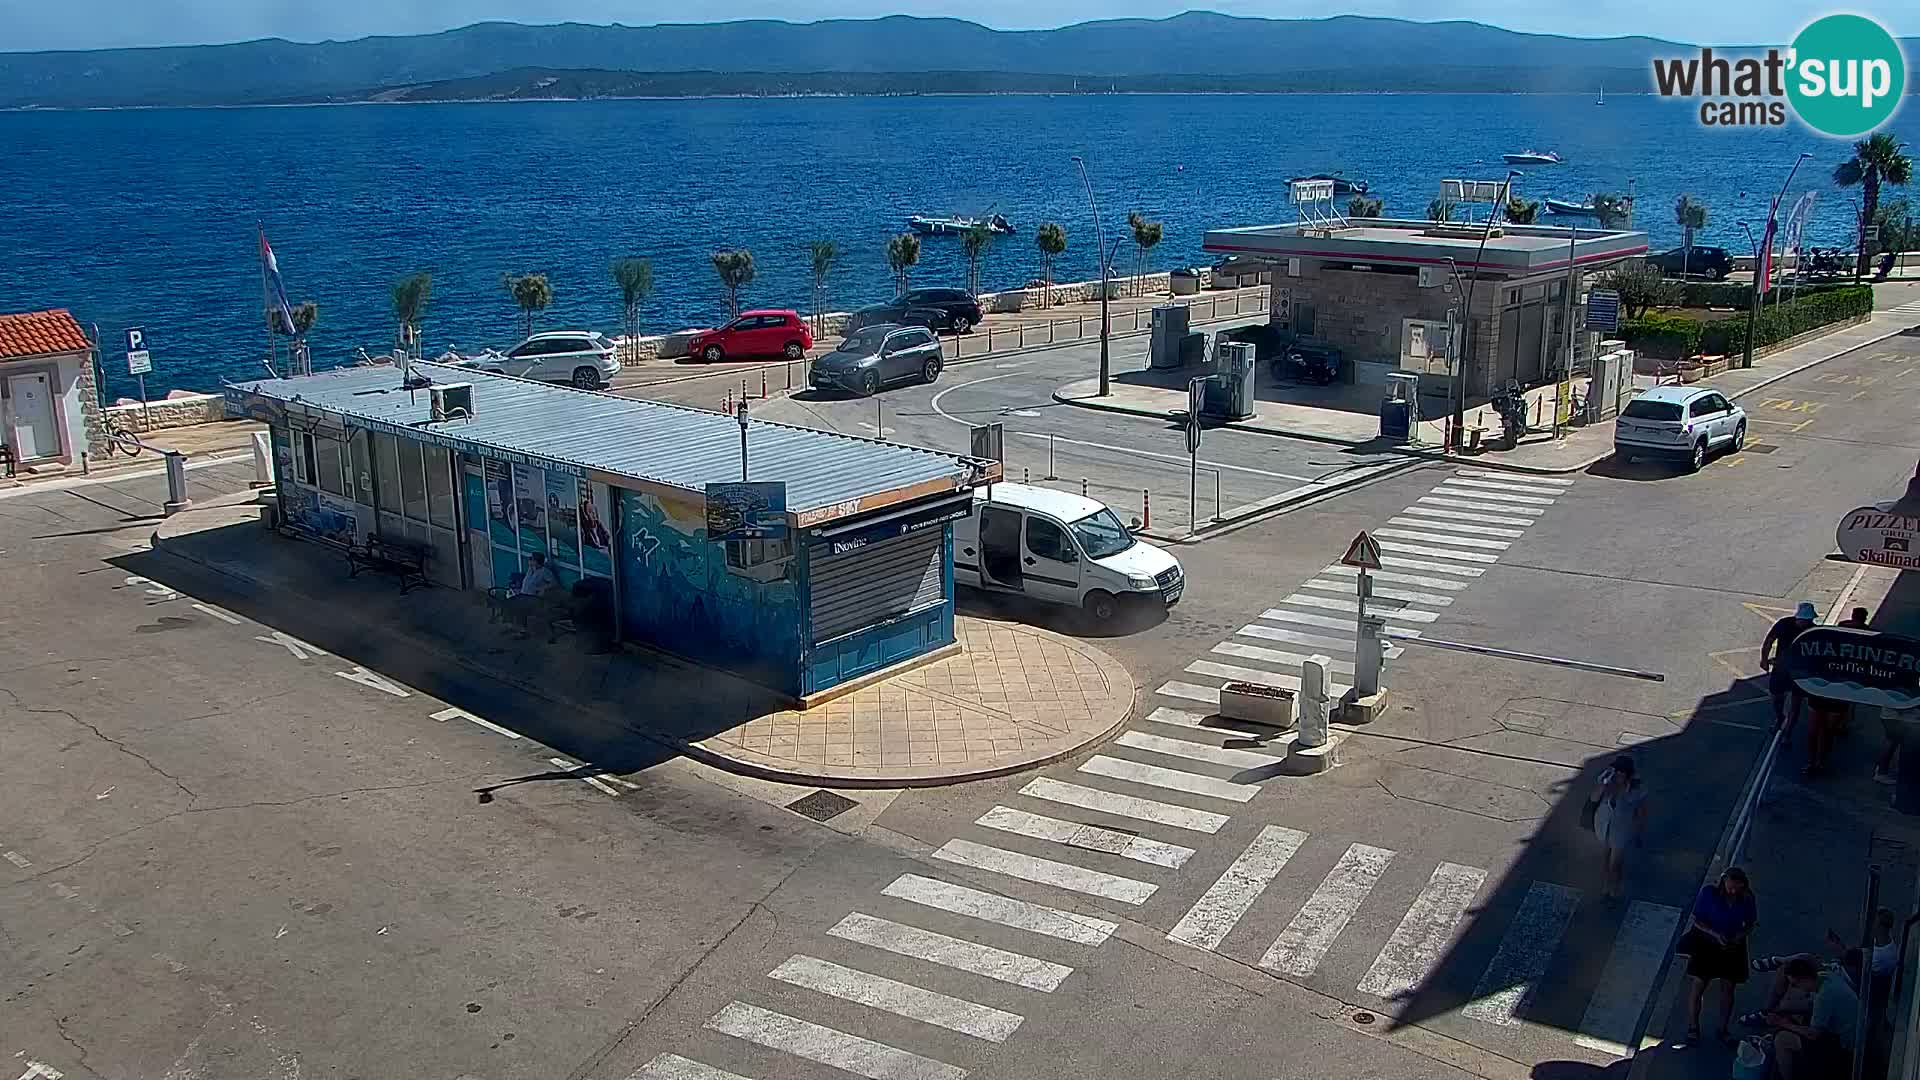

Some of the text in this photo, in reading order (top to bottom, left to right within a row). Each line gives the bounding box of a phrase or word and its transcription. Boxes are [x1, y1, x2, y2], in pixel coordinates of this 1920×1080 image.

[130, 331, 142, 349] P
[494, 448, 526, 465] STATION
[528, 456, 554, 470] TICKET
[555, 463, 582, 477] OFFICE
[1870, 664, 1896, 678] bar
